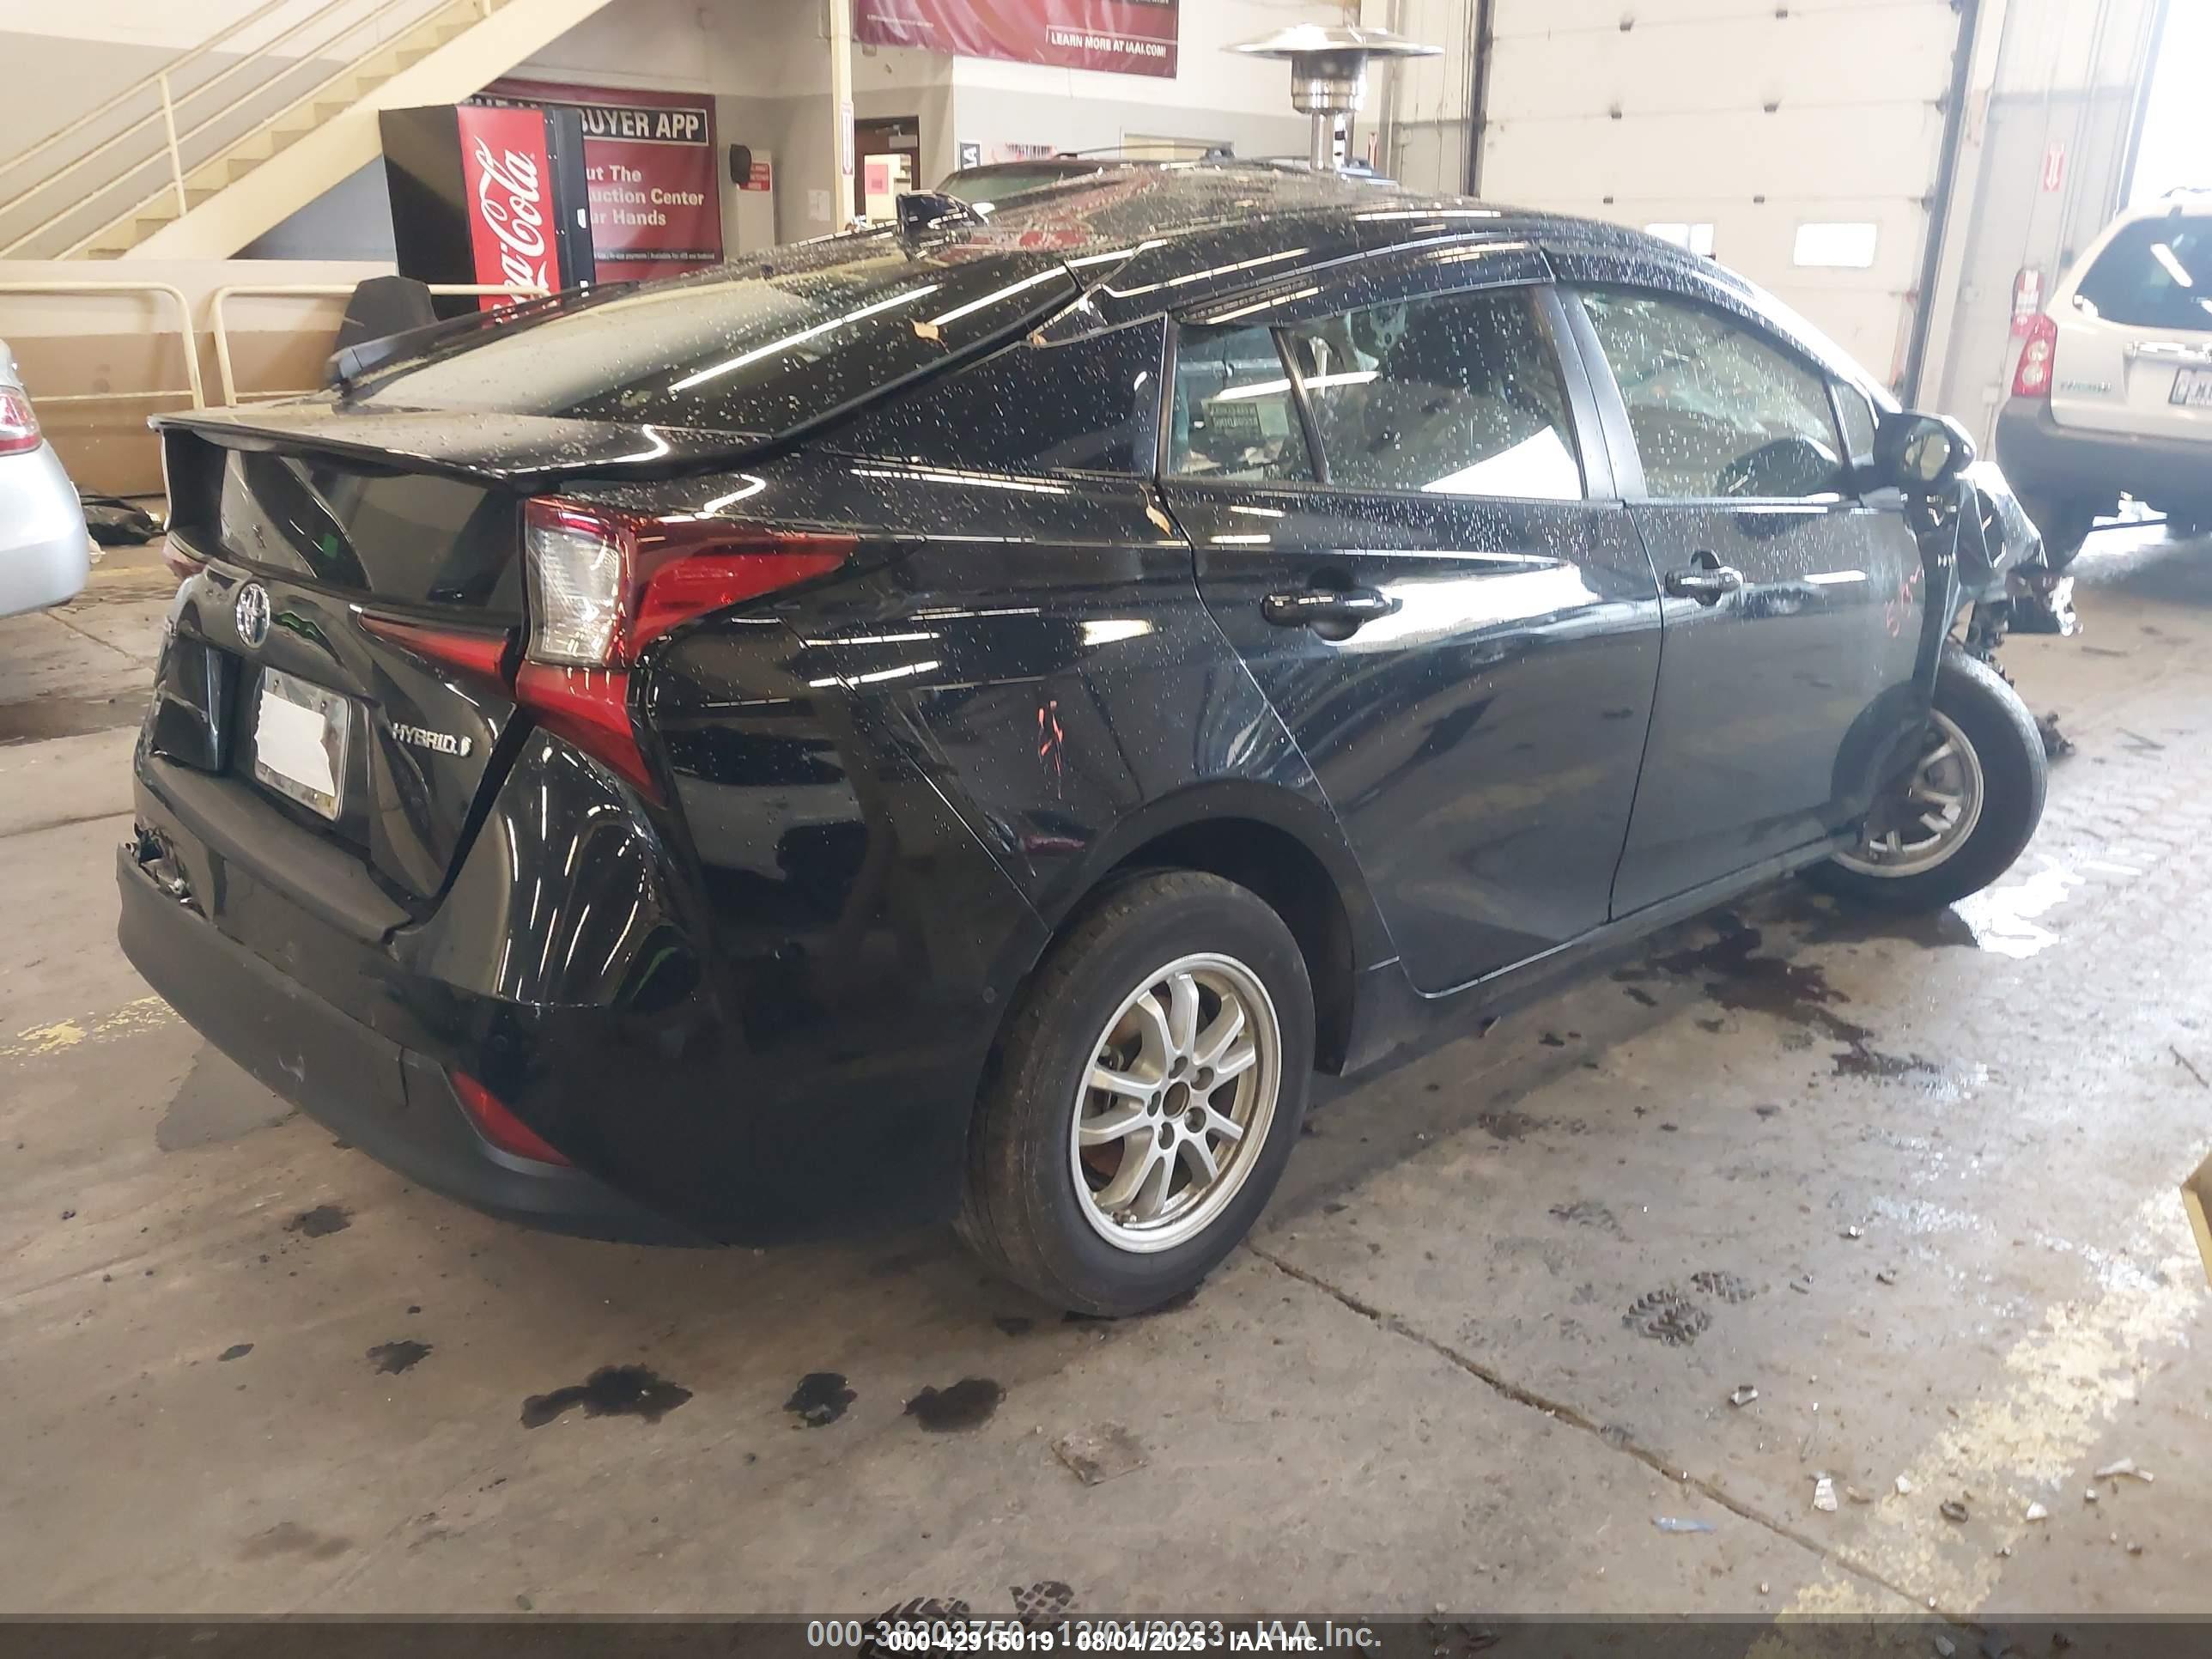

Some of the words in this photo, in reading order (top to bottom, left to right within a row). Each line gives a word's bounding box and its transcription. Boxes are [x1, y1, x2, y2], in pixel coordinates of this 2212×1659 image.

[1051, 31, 1083, 48] LEARN
[1085, 36, 1112, 52] MORE
[1113, 41, 1125, 52] AT
[655, 112, 700, 140] APP
[586, 167, 605, 181] ut
[609, 164, 642, 182] The
[589, 187, 646, 204] uction
[650, 187, 705, 206] Center
[590, 212, 606, 225] ur
[612, 208, 667, 227] Hands
